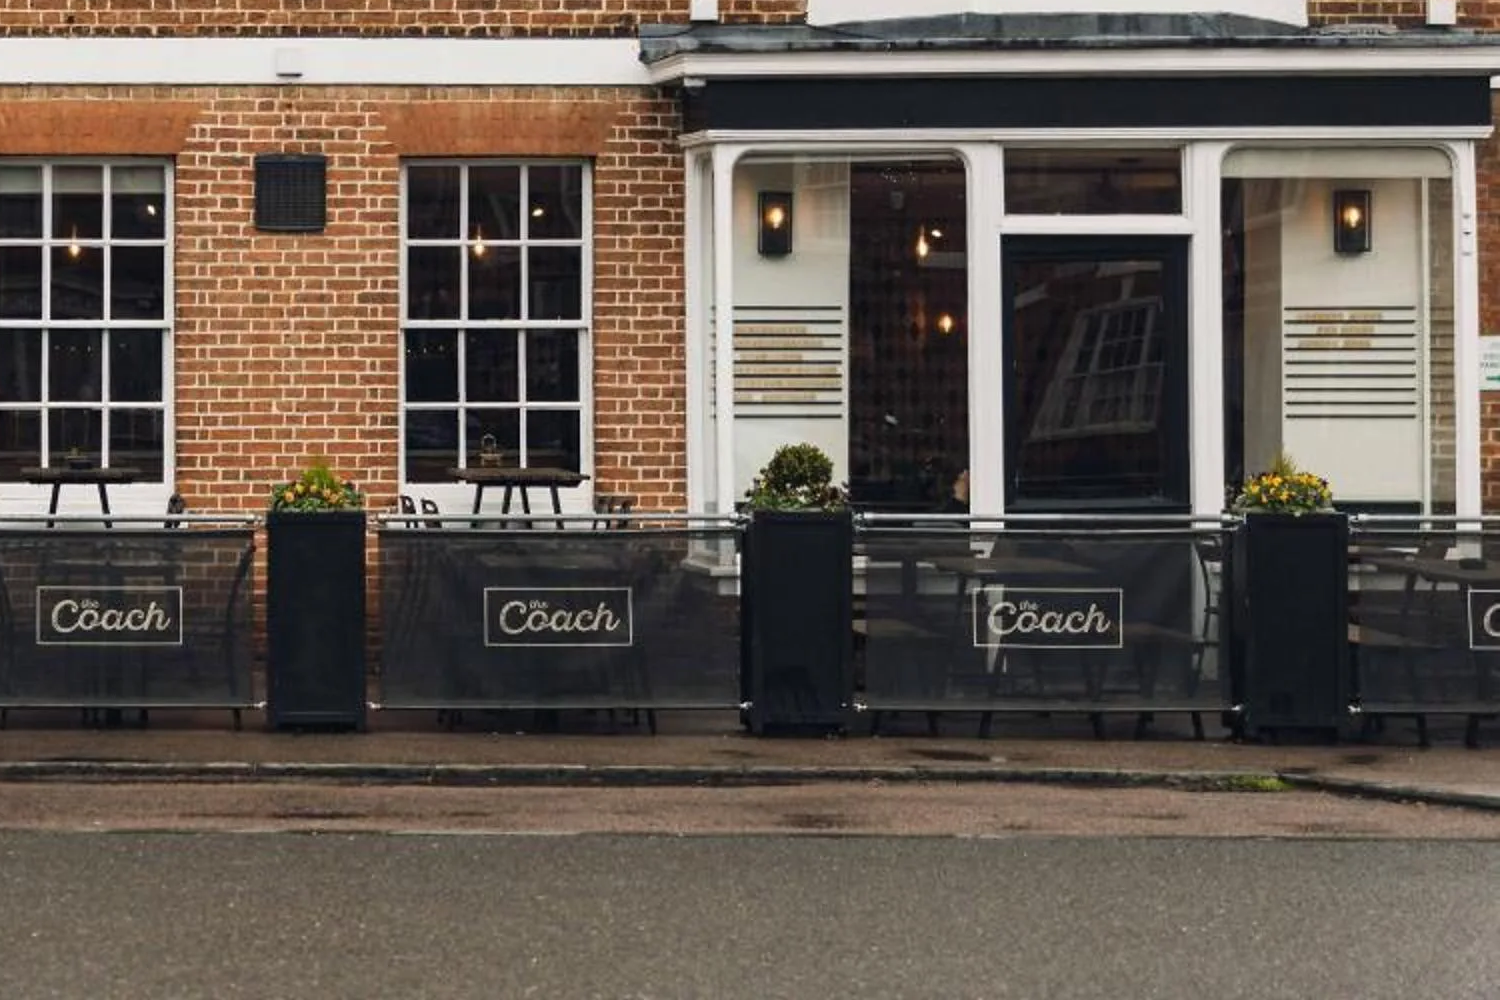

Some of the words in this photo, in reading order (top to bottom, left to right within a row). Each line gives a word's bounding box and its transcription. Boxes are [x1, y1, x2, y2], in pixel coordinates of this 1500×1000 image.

[51, 599, 171, 633] Coach
[500, 601, 621, 634] Coach
[987, 602, 1111, 634] Coach
[1020, 600, 1038, 610] the
